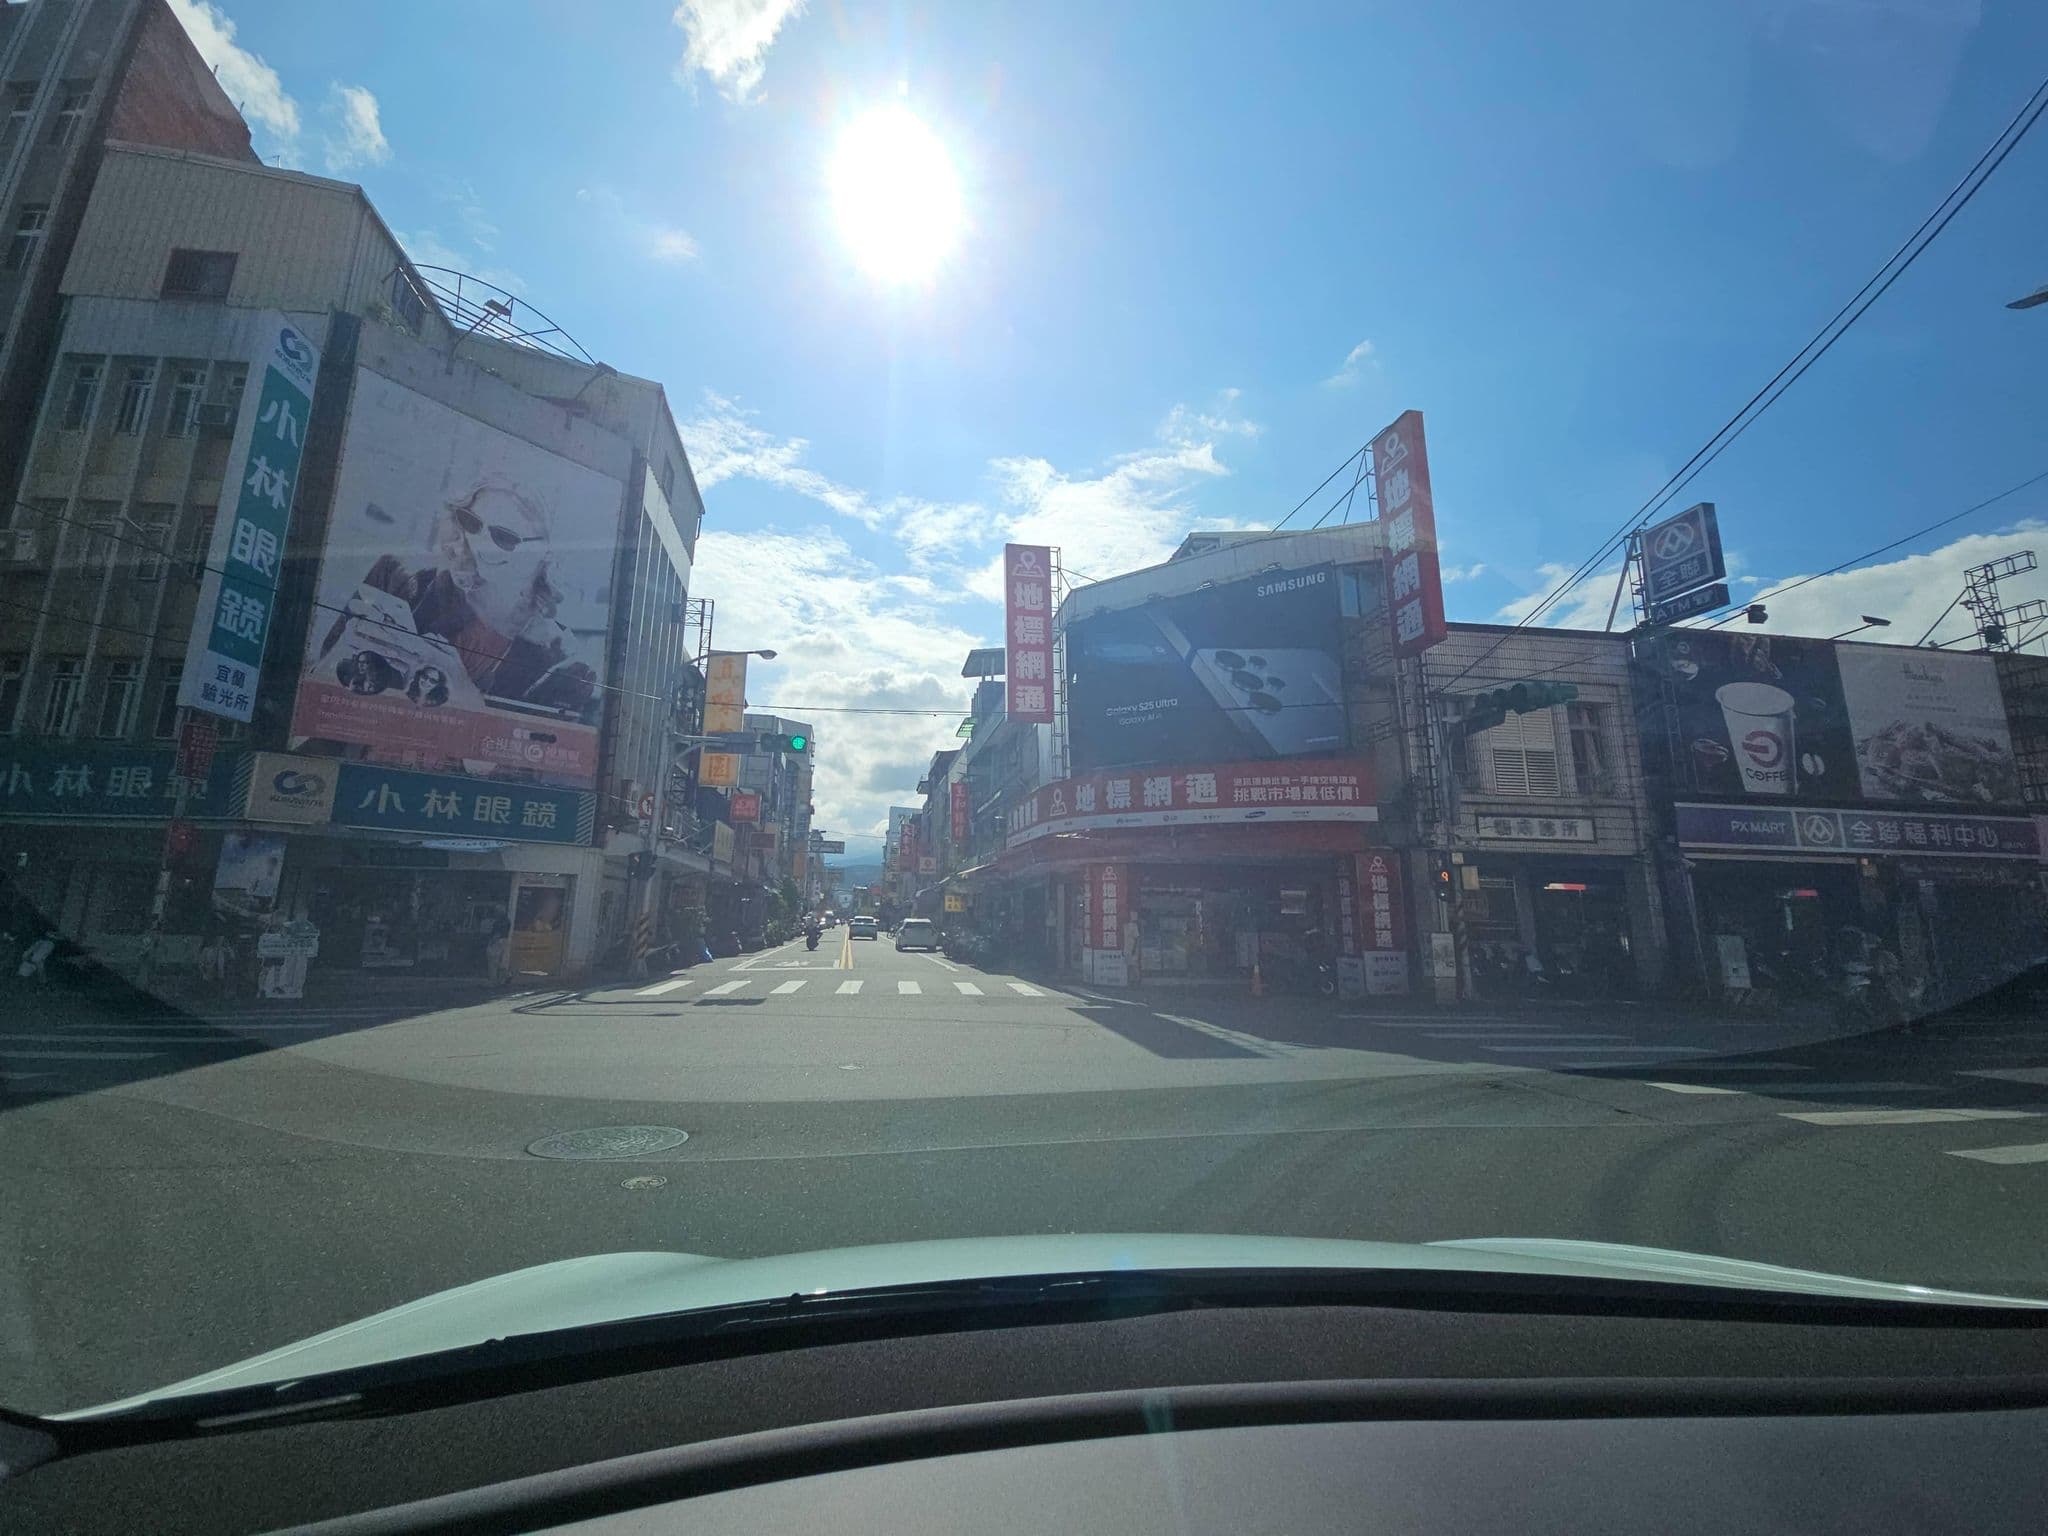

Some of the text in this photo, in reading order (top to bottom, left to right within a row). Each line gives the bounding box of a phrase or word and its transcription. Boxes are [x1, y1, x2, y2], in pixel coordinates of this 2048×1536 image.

[217, 398, 299, 646] 小林眼鏡
[1383, 468, 1426, 643] 地標網通
[1256, 572, 1326, 598] SAMSUNG
[1659, 560, 1702, 590] 全聯
[1656, 598, 1691, 621] ATM
[1013, 582, 1046, 713] 地標網通
[1138, 701, 1154, 712] S25
[358, 783, 559, 829] 小林眼鏡
[1075, 773, 1218, 812] 地標網通
[1750, 821, 1786, 834] MART
[1850, 820, 1999, 848] 全聯福利中心
